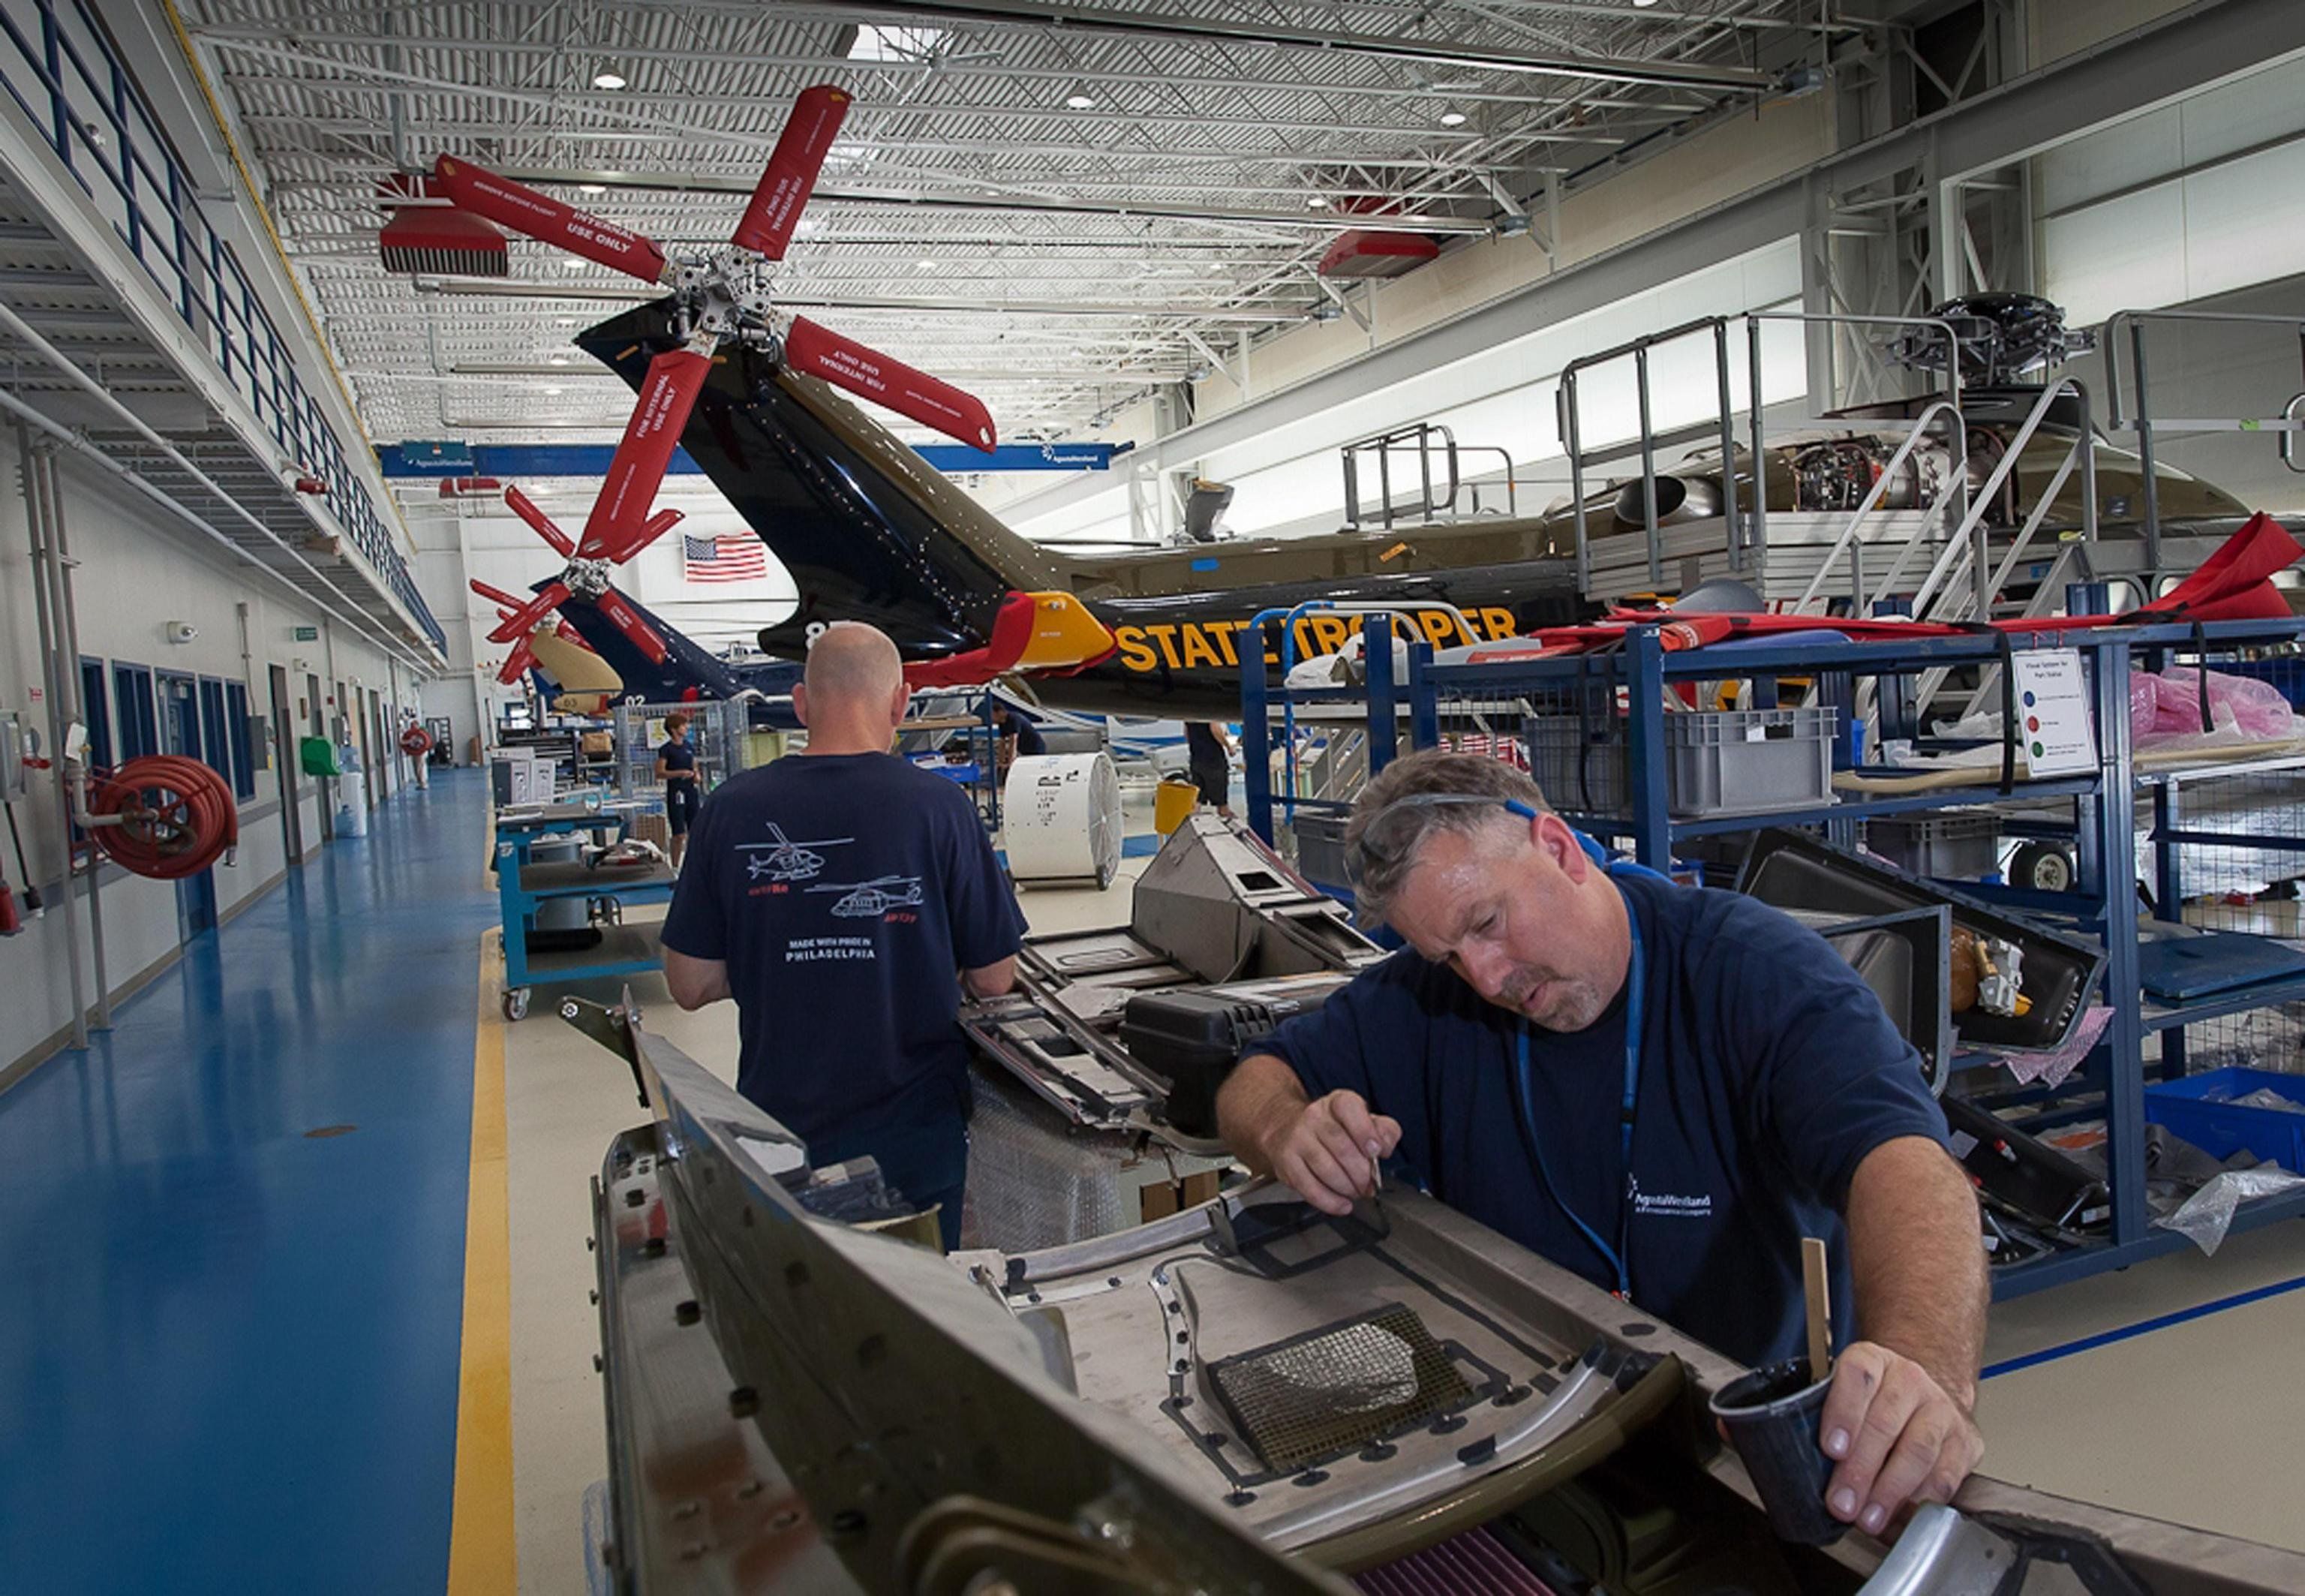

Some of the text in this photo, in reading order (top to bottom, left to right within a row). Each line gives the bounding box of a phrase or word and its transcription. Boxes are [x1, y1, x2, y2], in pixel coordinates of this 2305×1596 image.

[566, 222, 631, 254] USE ONLY
[819, 354, 886, 392] FOR INTERNAL
[832, 349, 879, 377] USE ONLY
[1279, 607, 1516, 660] TRPER
[786, 948, 876, 963] PHILADELPHIA
[789, 939, 815, 949] MADE
[816, 938, 837, 948] WITH
